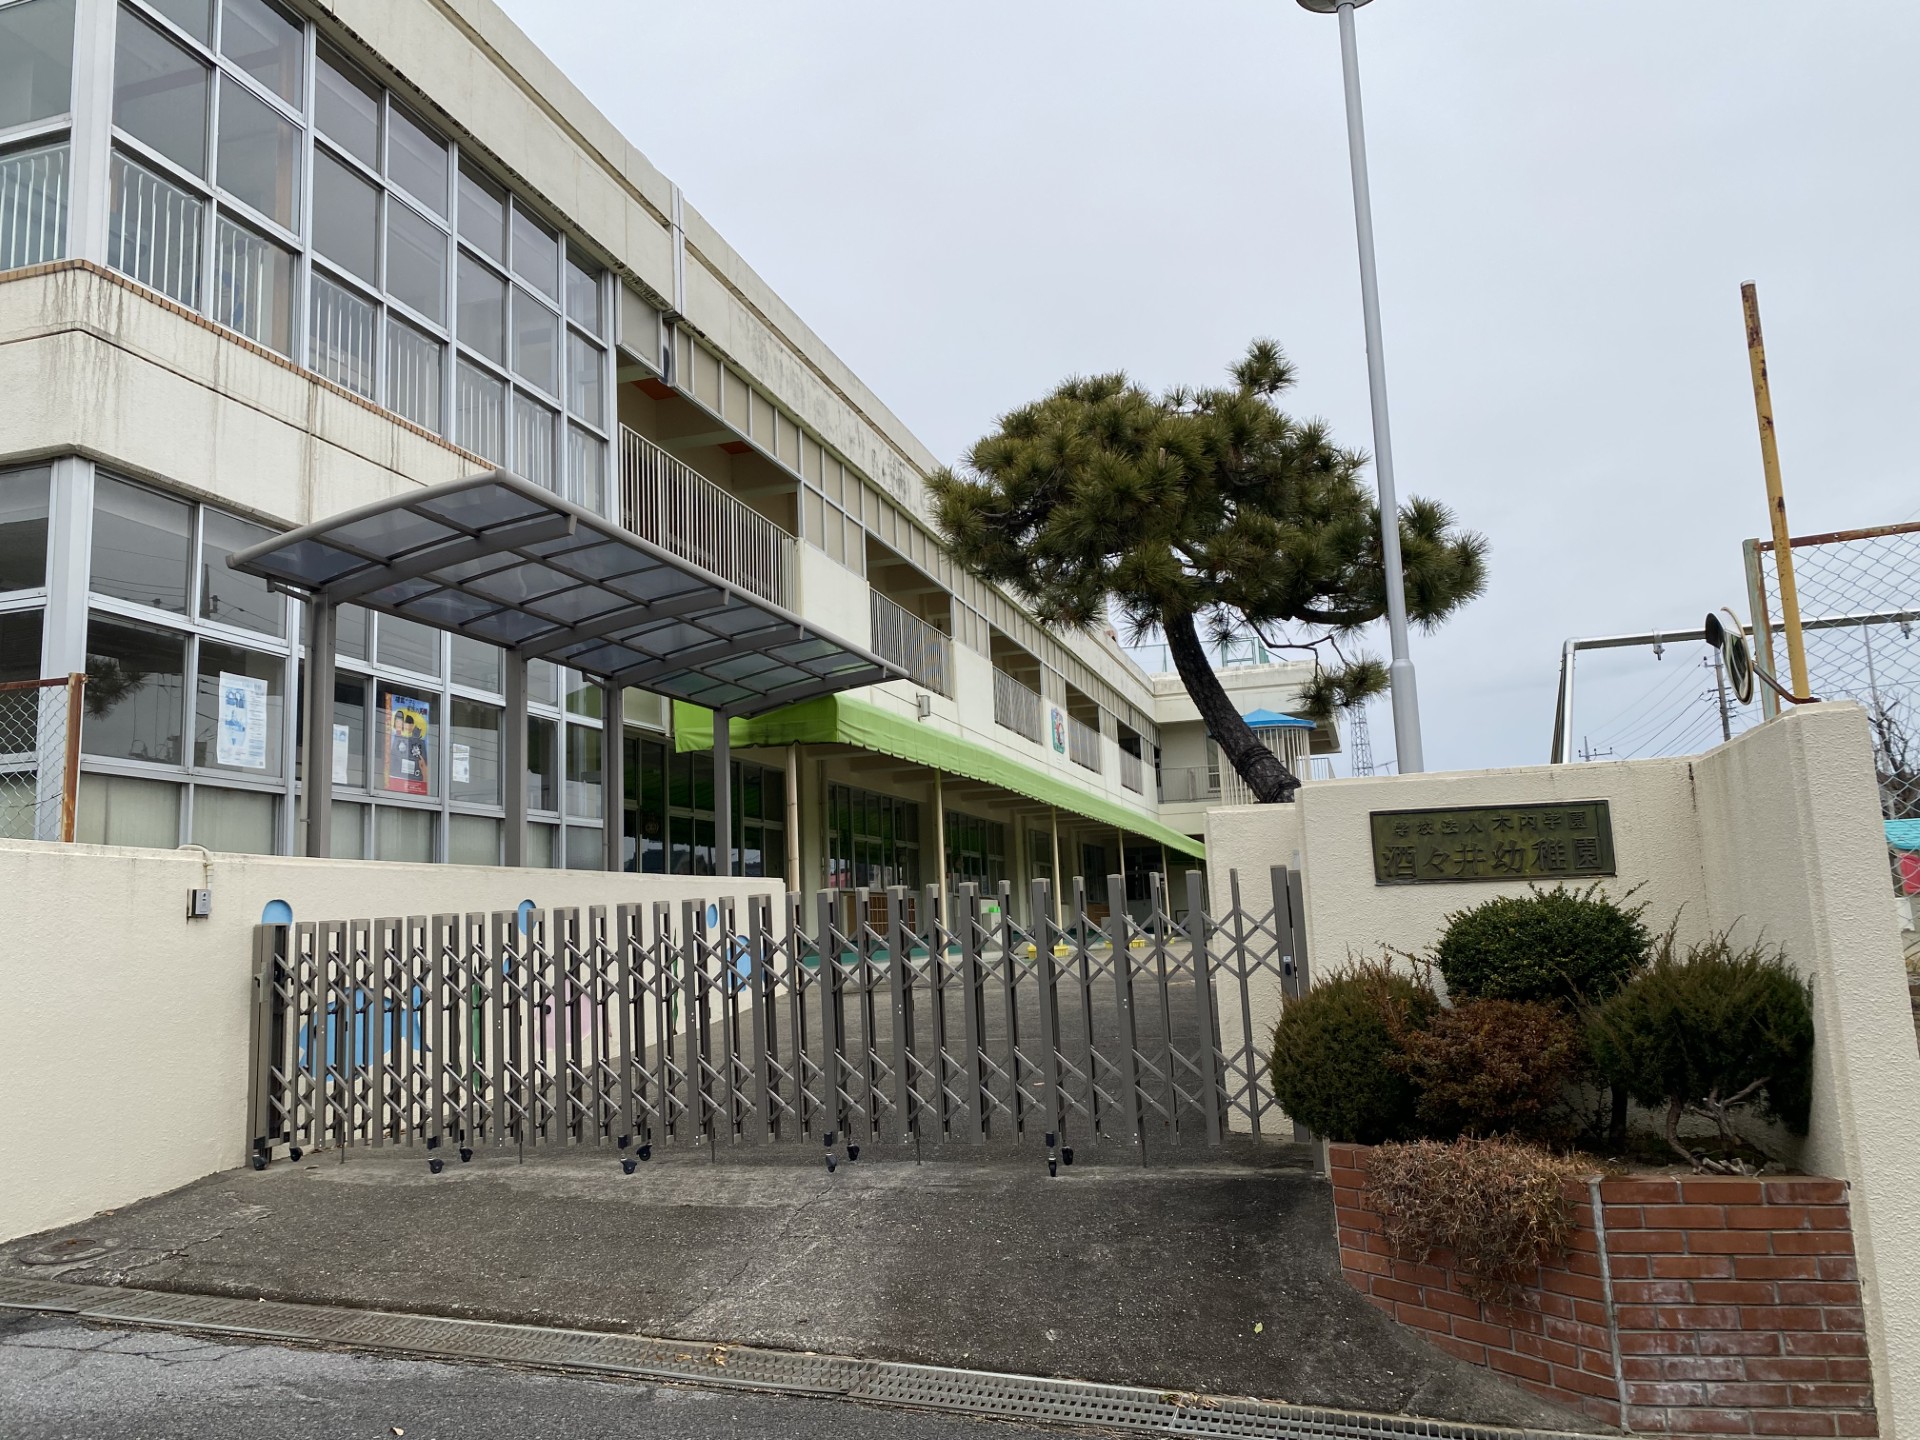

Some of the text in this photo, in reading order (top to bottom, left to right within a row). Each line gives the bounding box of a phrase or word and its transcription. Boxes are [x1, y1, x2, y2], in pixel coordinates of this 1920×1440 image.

[1382, 836, 1602, 878] 酒々井幼稚園
